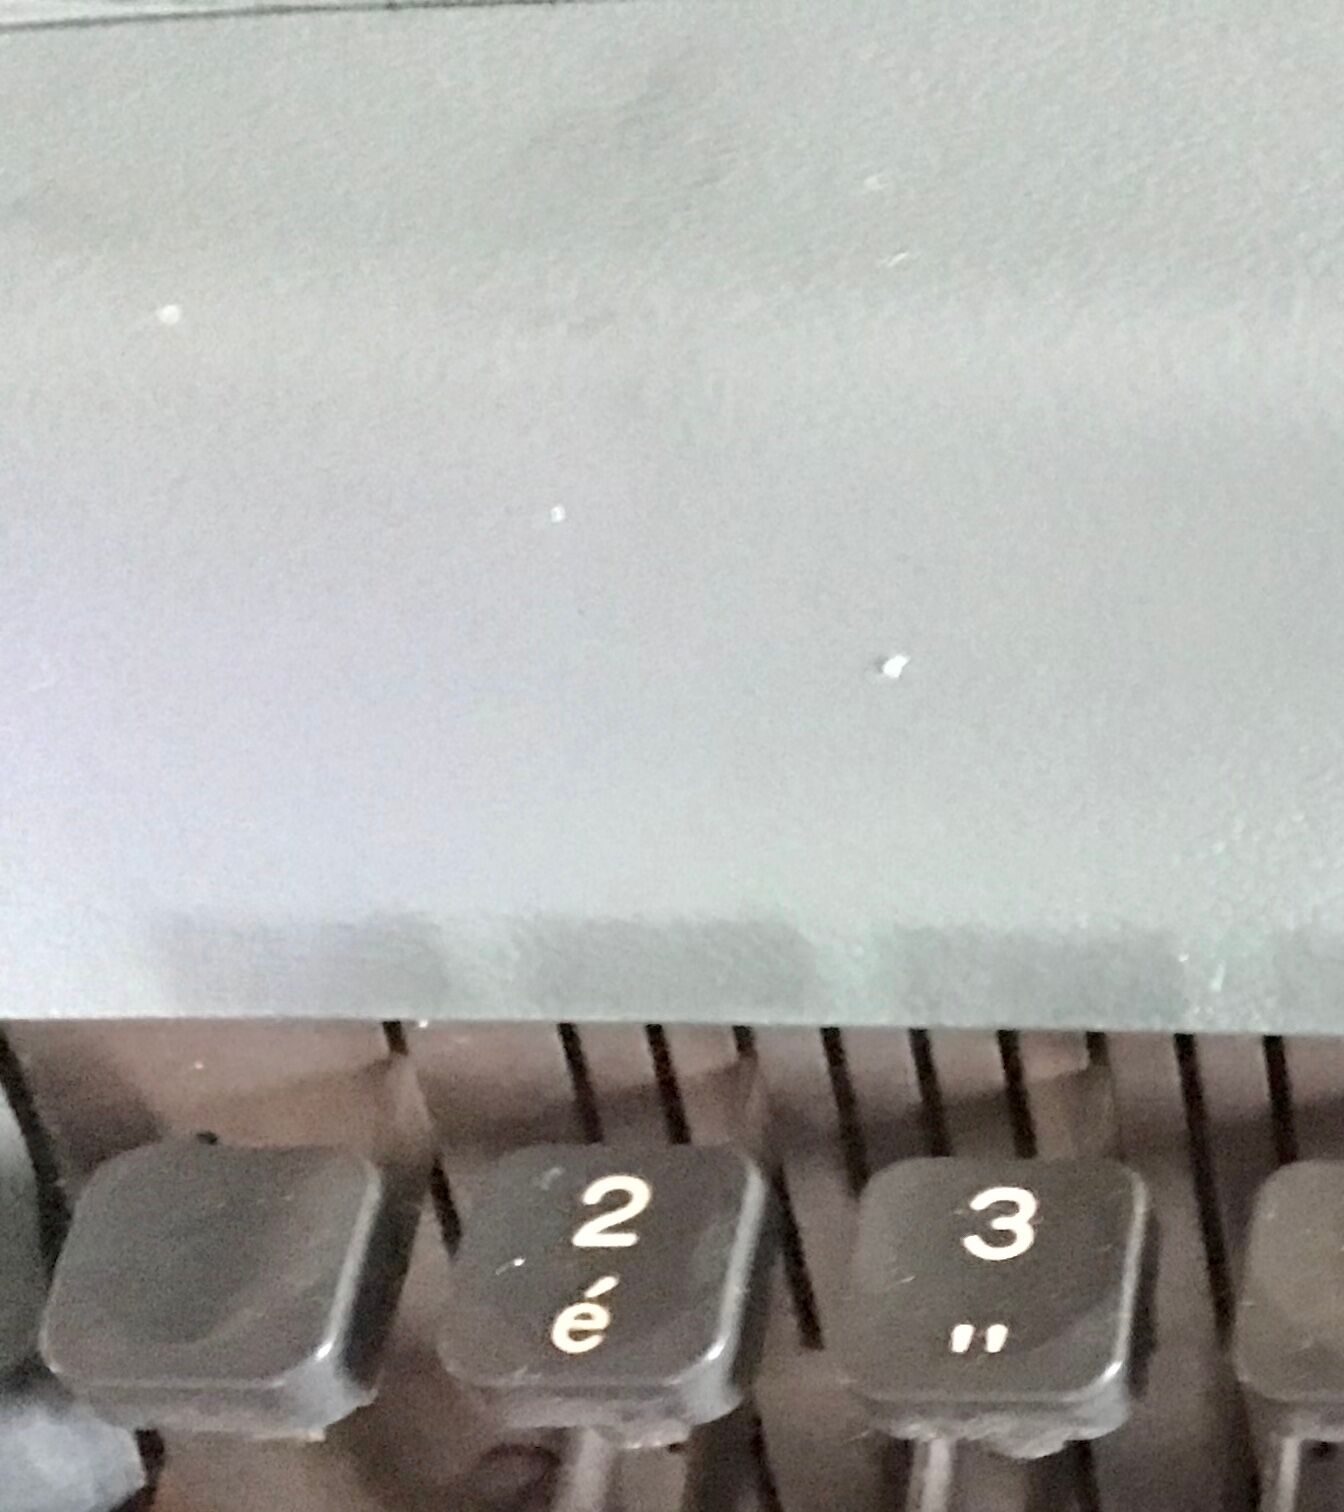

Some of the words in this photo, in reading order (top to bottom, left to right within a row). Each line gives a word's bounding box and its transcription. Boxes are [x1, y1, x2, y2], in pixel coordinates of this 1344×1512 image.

[571, 1174, 652, 1249] 2
[961, 1185, 1038, 1262] 3
[550, 1275, 619, 1355] é
